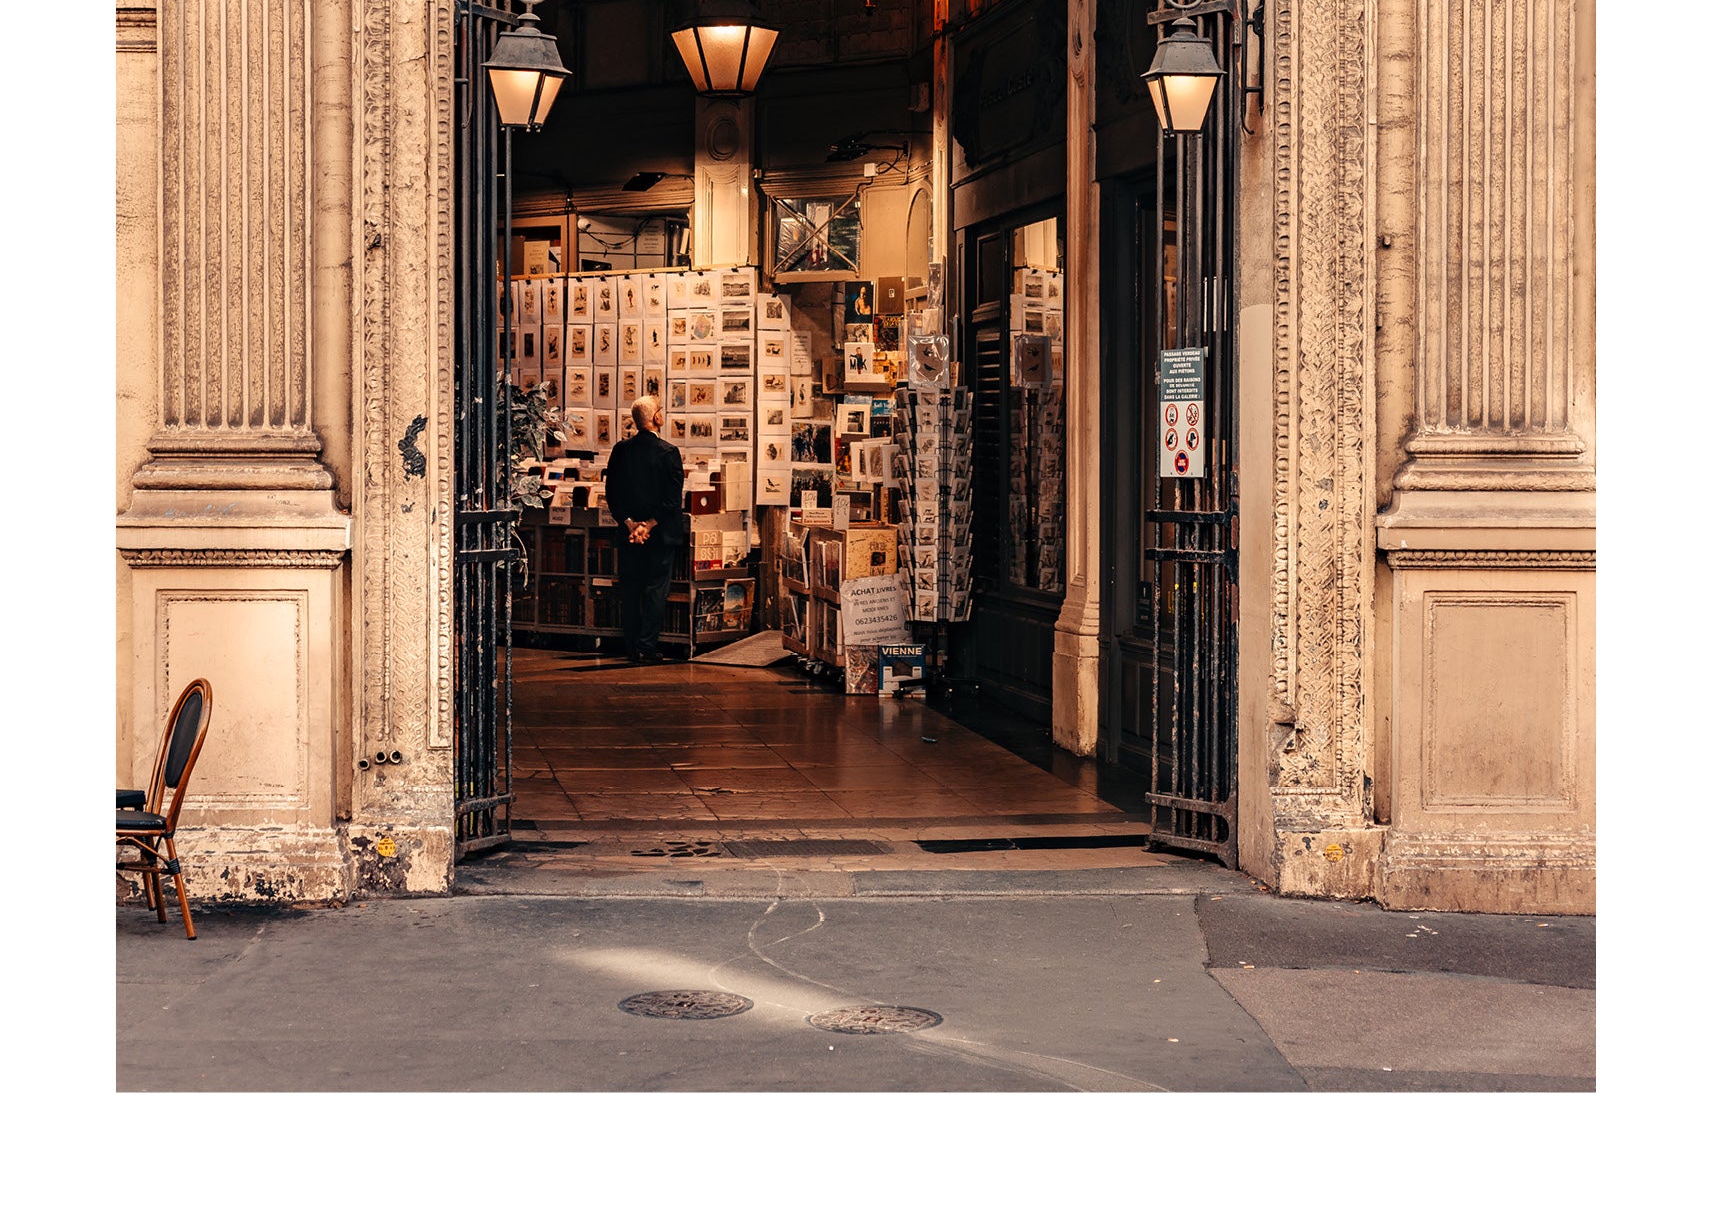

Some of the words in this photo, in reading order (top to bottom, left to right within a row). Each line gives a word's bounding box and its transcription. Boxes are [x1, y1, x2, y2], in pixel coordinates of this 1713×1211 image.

[851, 588, 875, 596] ACHAT
[876, 586, 897, 594] LIVRES
[869, 597, 889, 605] ANCIENS
[855, 614, 898, 625] 0623435426
[881, 647, 922, 655] VIENNE
